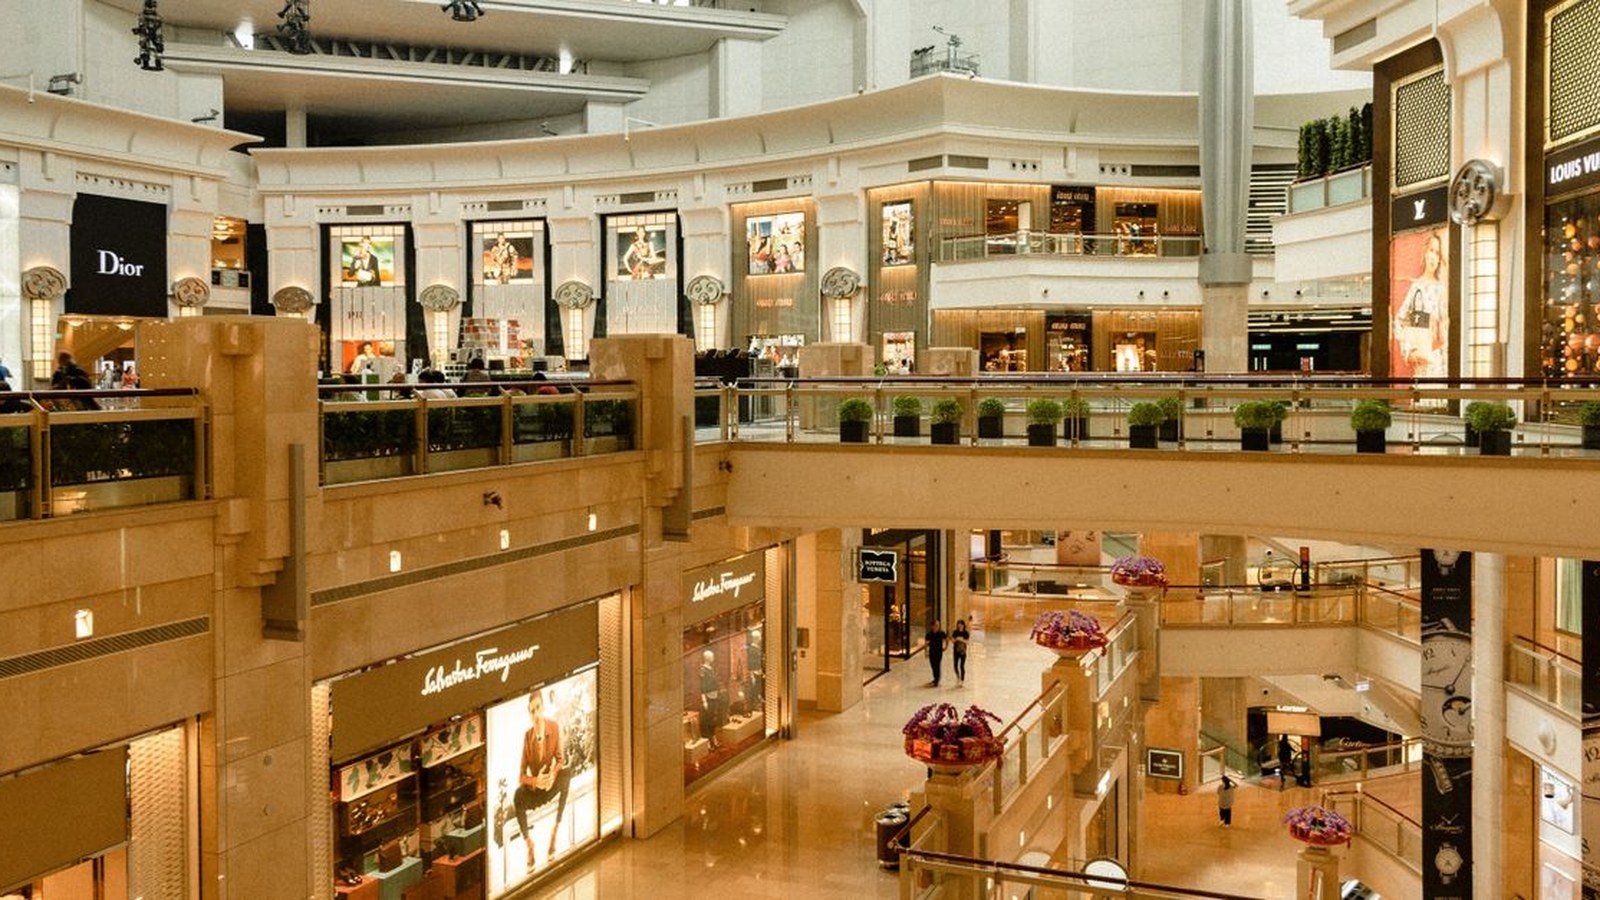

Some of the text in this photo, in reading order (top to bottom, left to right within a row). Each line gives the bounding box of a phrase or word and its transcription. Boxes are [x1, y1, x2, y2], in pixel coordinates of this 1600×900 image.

[1550, 158, 1582, 184] LOUIS
[96, 249, 144, 277] Dior
[421, 644, 540, 696] Salvatore Ferragamo
